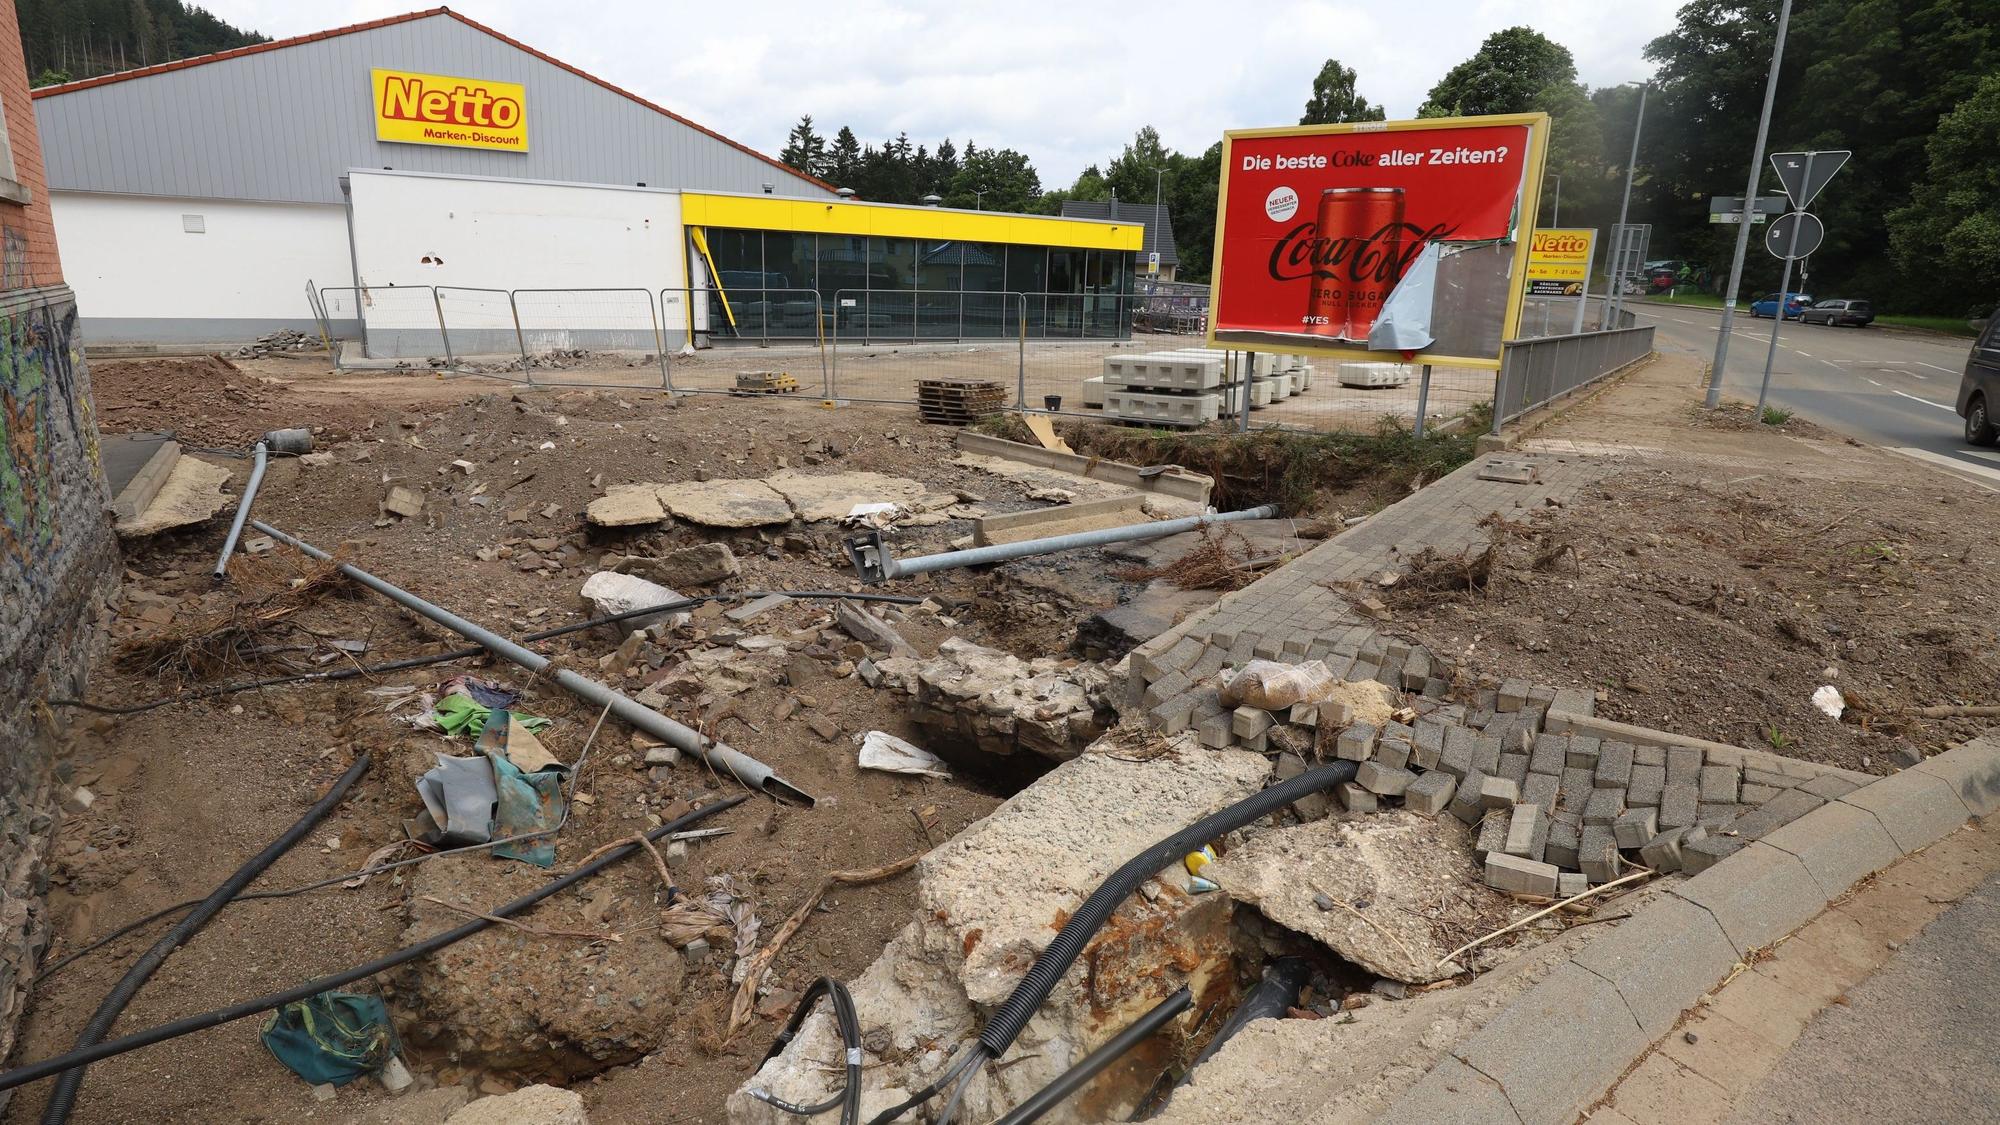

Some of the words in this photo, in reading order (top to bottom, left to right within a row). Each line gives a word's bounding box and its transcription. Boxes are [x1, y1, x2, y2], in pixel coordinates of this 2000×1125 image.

[382, 76, 520, 129] Netto
[424, 128, 519, 144] Marken-Discount
[1243, 154, 1271, 170] Die
[1275, 153, 1327, 169] beste
[1332, 150, 1375, 167] Coke
[1379, 150, 1424, 166] aller
[1428, 146, 1508, 165] Zeiten?
[1270, 195, 1294, 206] NEUER
[1532, 234, 1588, 253] Netto
[1349, 290, 1386, 301] SUGA
[1302, 315, 1329, 325] #YES
